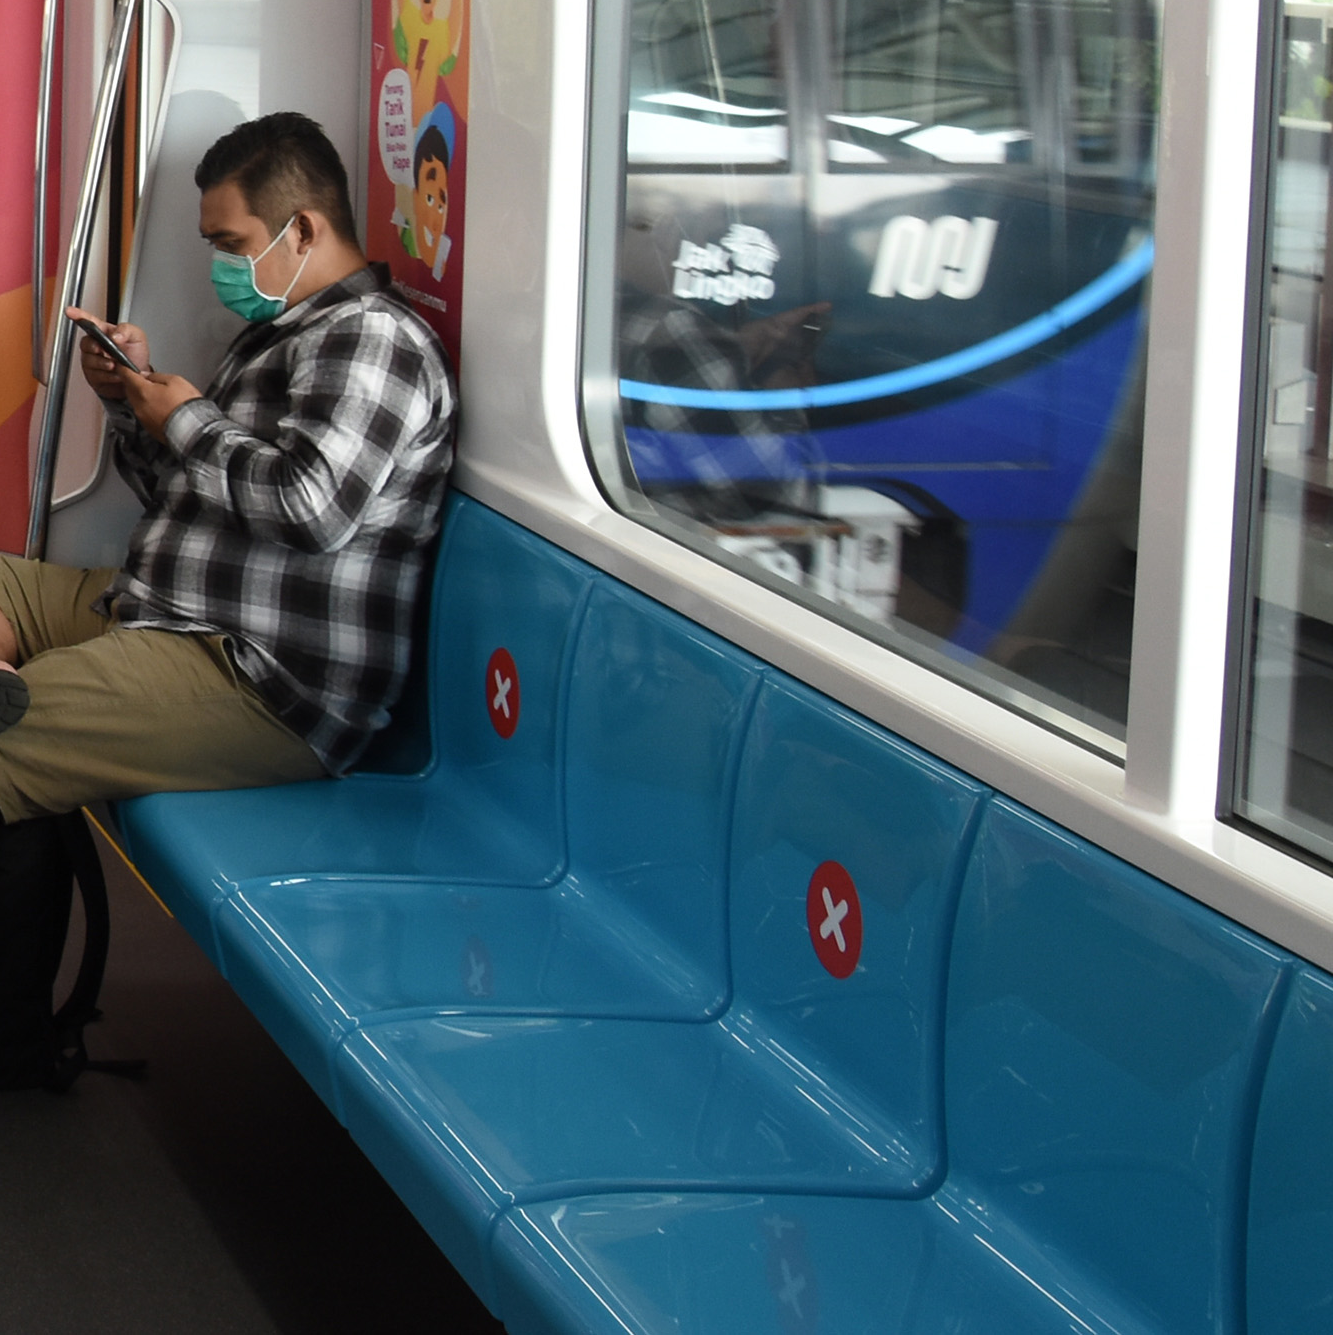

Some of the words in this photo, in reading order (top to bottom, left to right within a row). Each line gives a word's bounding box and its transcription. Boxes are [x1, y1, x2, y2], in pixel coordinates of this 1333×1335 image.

[384, 99, 405, 116] Tarik
[385, 121, 406, 138] Tunai
[392, 154, 411, 170] Hape
